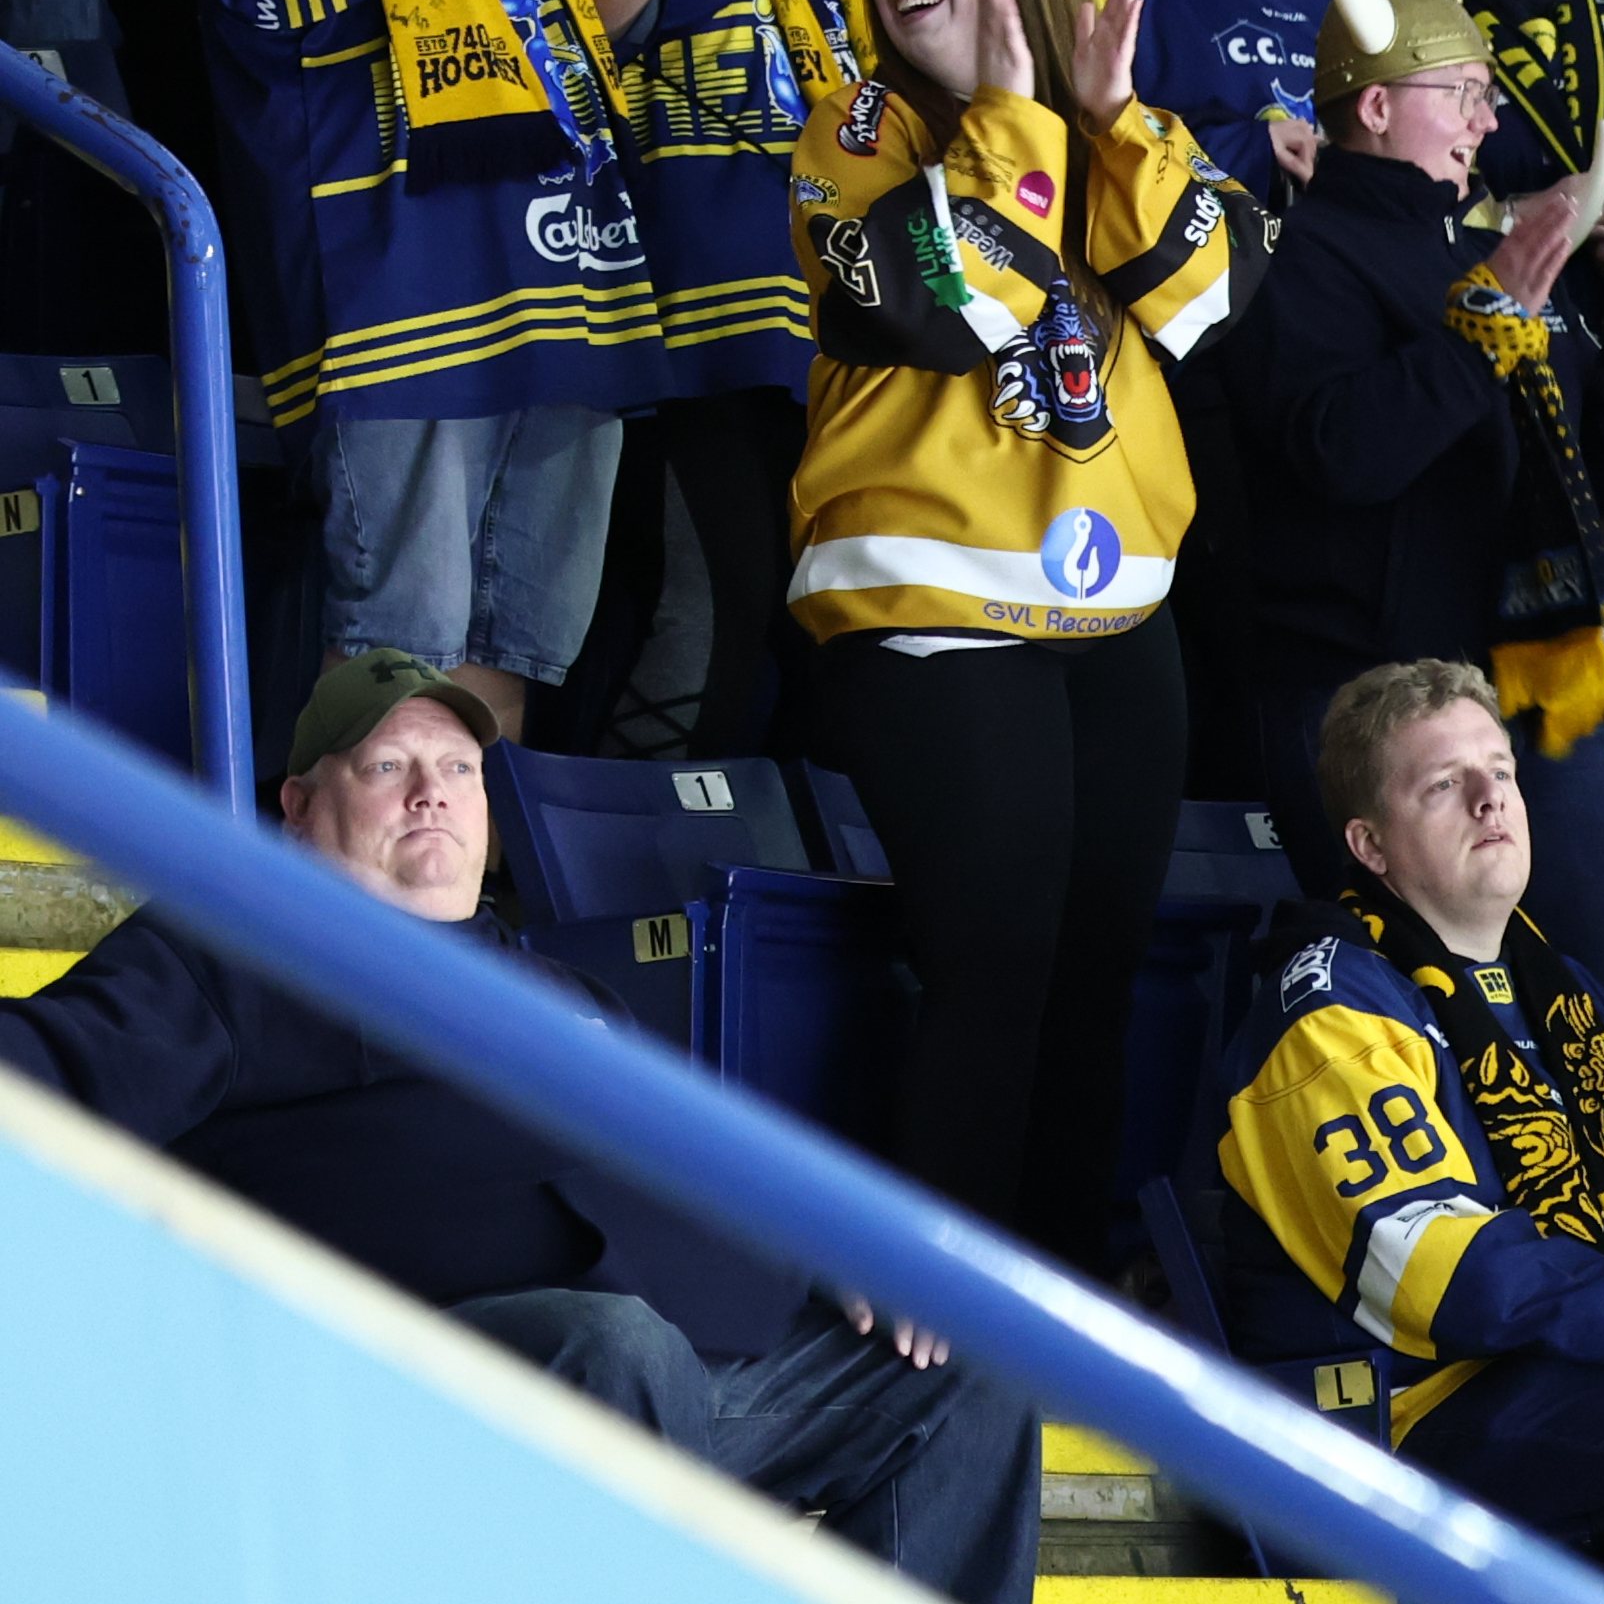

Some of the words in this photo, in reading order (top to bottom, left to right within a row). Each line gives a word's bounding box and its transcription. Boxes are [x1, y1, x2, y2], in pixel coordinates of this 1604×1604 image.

[1227, 37, 1284, 64] C.C.
[81, 369, 99, 402] 1
[3, 494, 22, 533] N
[983, 600, 1037, 629] GVL
[1046, 608, 1146, 635] Recovery
[694, 774, 712, 808] 1
[648, 917, 673, 958] M
[1314, 1083, 1447, 1199] 38
[1334, 1366, 1353, 1405] L
